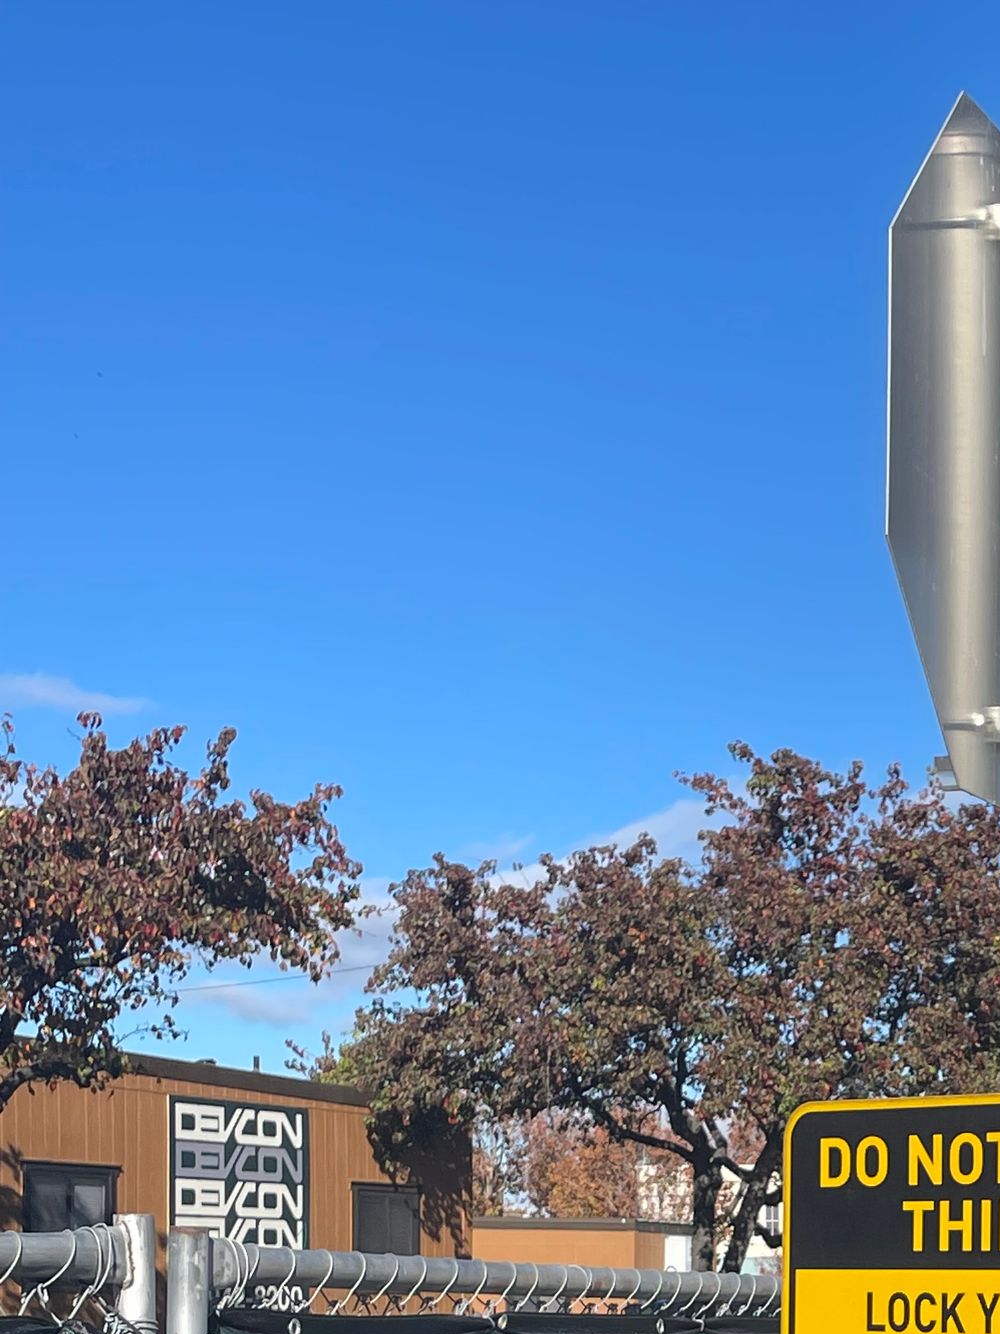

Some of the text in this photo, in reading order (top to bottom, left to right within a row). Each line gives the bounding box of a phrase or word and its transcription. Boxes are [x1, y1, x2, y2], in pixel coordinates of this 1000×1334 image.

[175, 1102, 303, 1149] DEVCON
[175, 1141, 303, 1184] DEVCON
[819, 1135, 889, 1188] DO
[175, 1178, 303, 1220] DEVCON
[175, 1216, 303, 1250] VCON
[866, 1291, 966, 1334] LOCK
